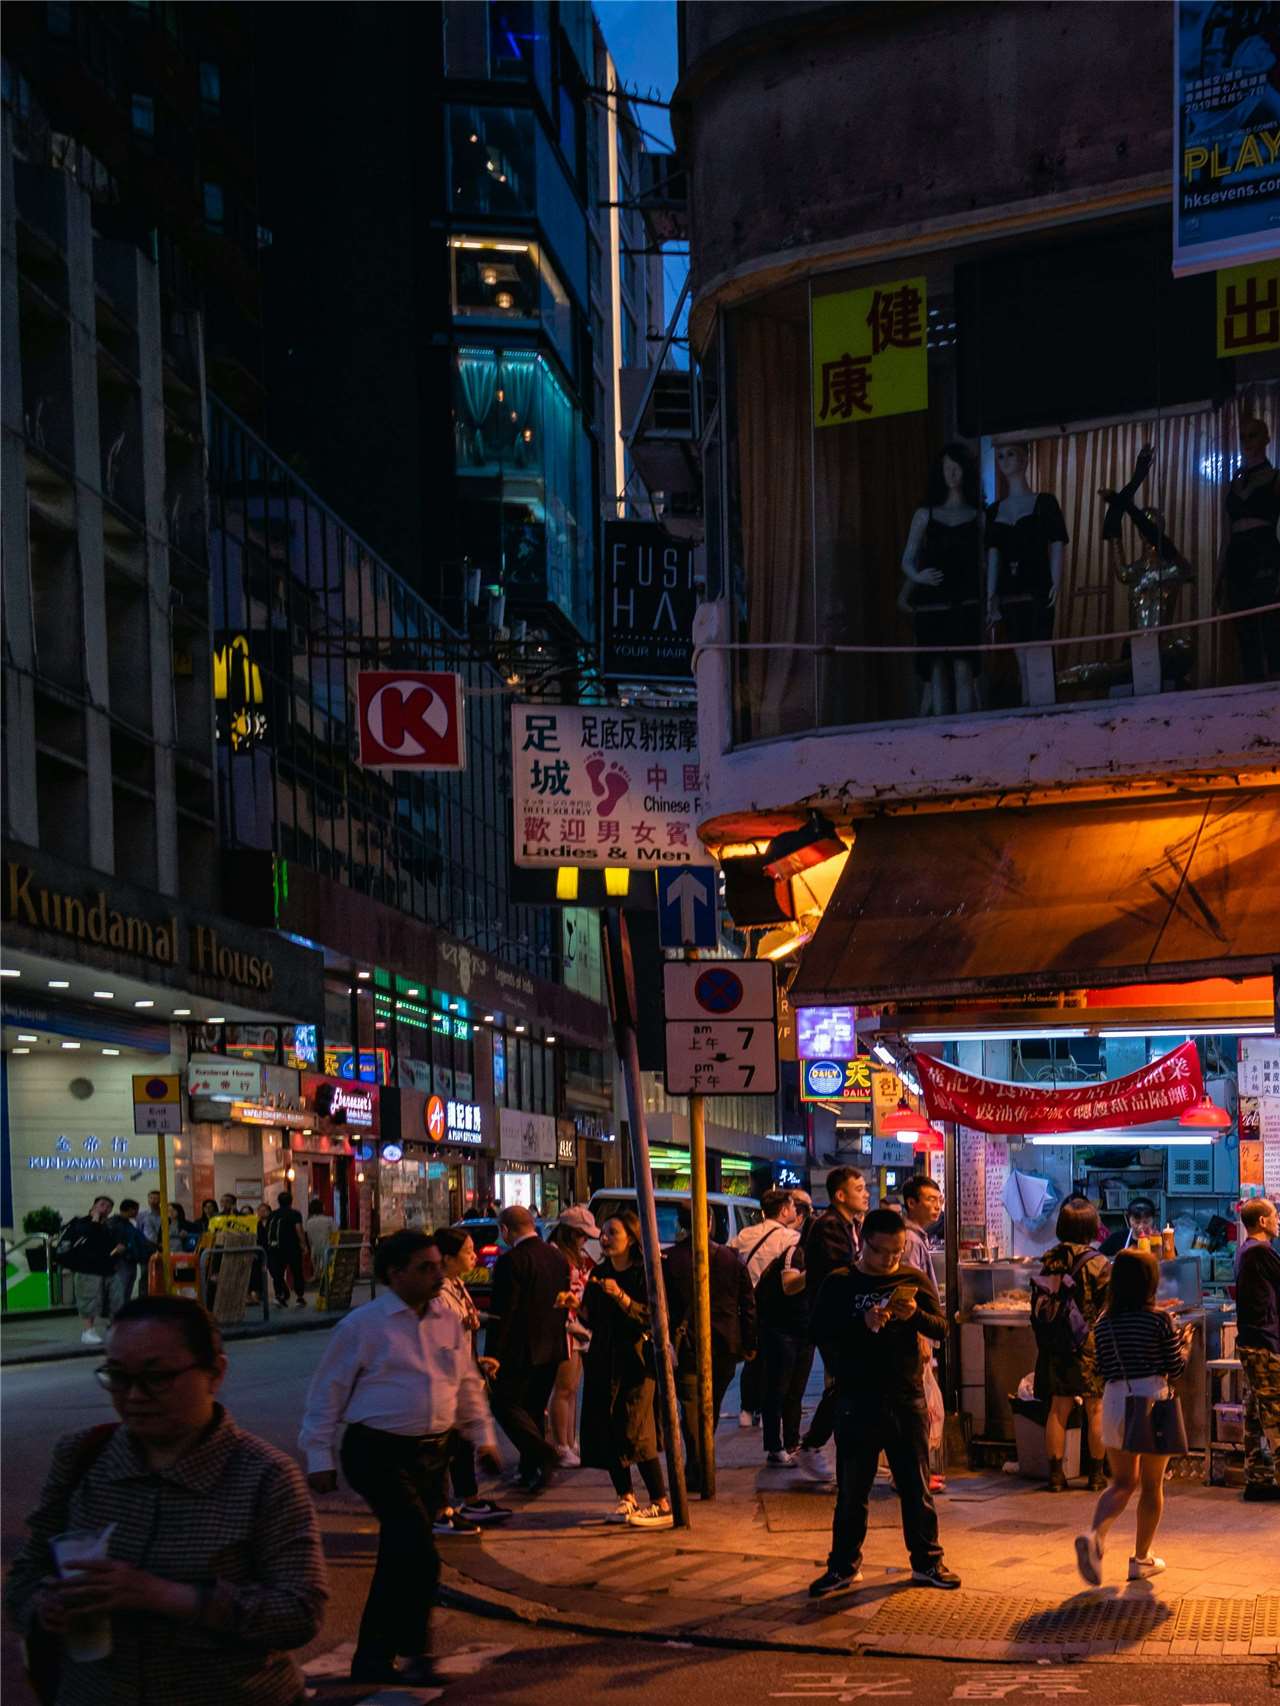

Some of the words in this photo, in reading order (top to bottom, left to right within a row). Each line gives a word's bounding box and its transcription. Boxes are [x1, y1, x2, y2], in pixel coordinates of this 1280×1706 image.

[613, 544, 692, 589] FUSI
[613, 588, 677, 630] HA
[615, 649, 648, 657] YOUR
[656, 649, 687, 658] HAIR
[580, 716, 697, 752] 足底反射按摩
[645, 763, 701, 795] 中國
[643, 796, 690, 814] Chinese
[522, 844, 600, 861] Ladies
[608, 846, 628, 860] &
[636, 847, 691, 861] Men
[7, 862, 178, 964] Kundamal
[194, 925, 273, 988] House
[689, 1037, 719, 1050] 上午
[693, 1026, 712, 1034] am
[737, 1027, 755, 1050] 7
[690, 1076, 720, 1089] 下午
[694, 1064, 714, 1074] pm
[739, 1065, 756, 1088] 7
[811, 1069, 840, 1079] DAILY
[843, 1088, 871, 1097] DAILY
